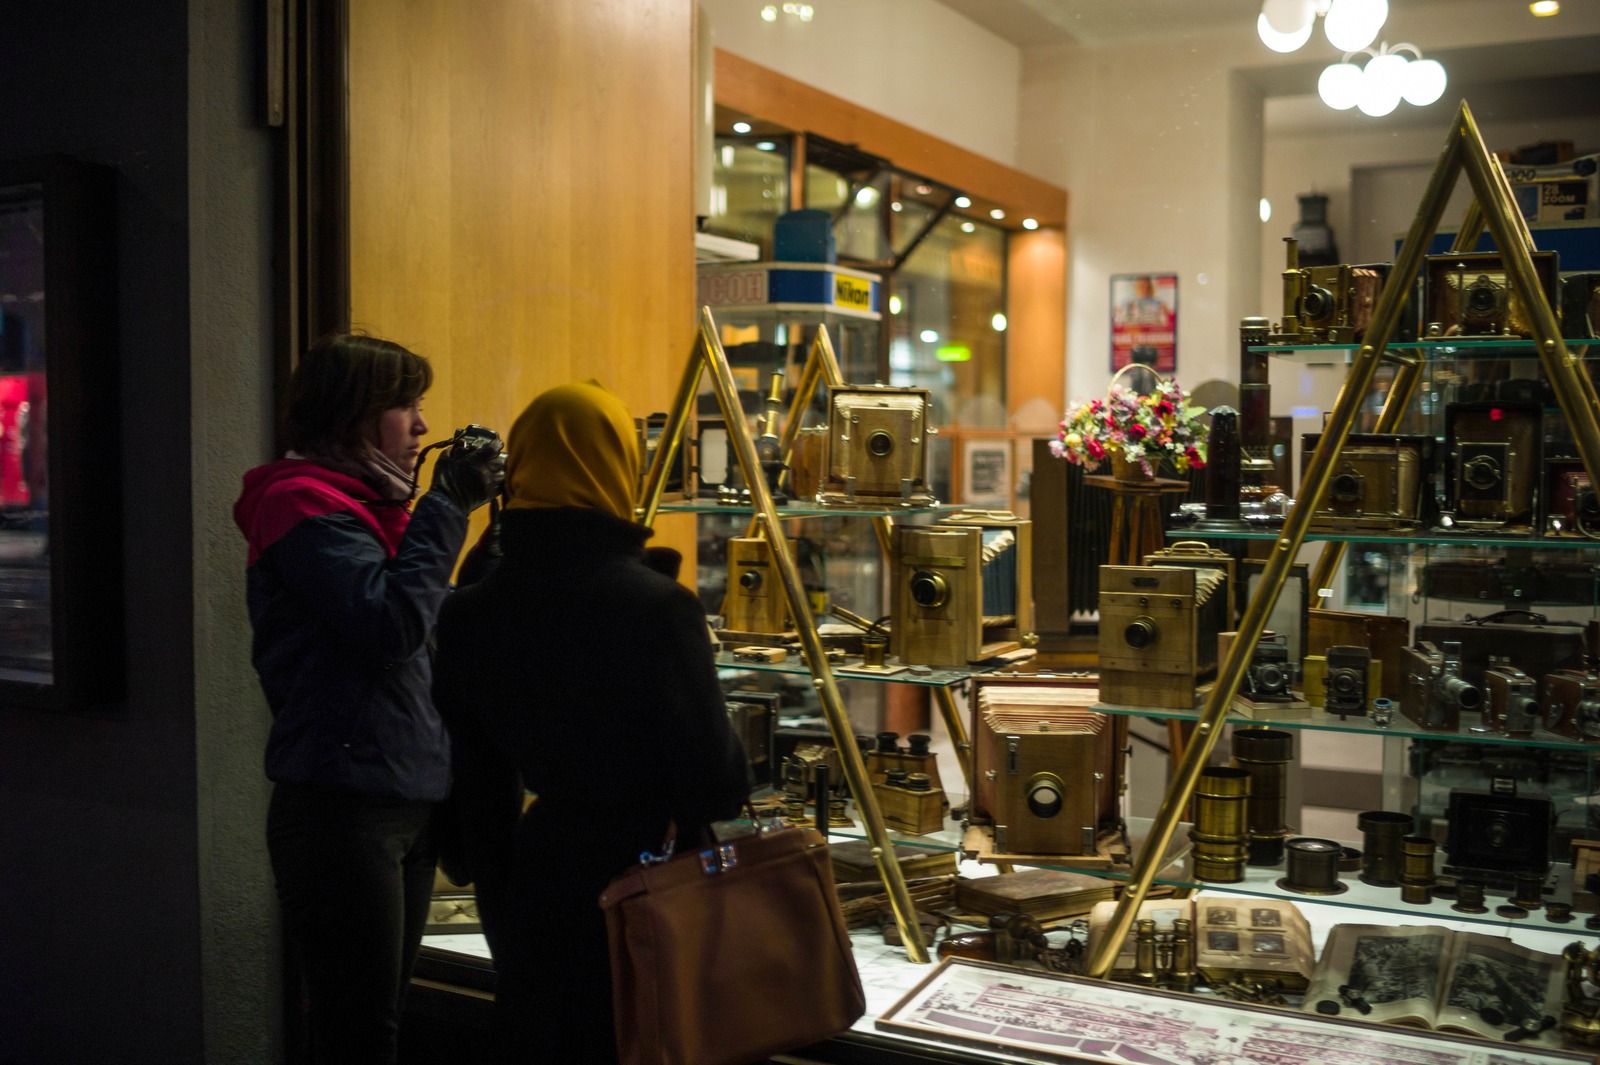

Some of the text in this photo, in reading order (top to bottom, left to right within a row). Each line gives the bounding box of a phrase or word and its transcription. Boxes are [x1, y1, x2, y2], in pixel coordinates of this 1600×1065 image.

[1543, 195, 1575, 203] ZOOM
[698, 272, 762, 303] ICOH
[836, 280, 868, 305] Nikon
